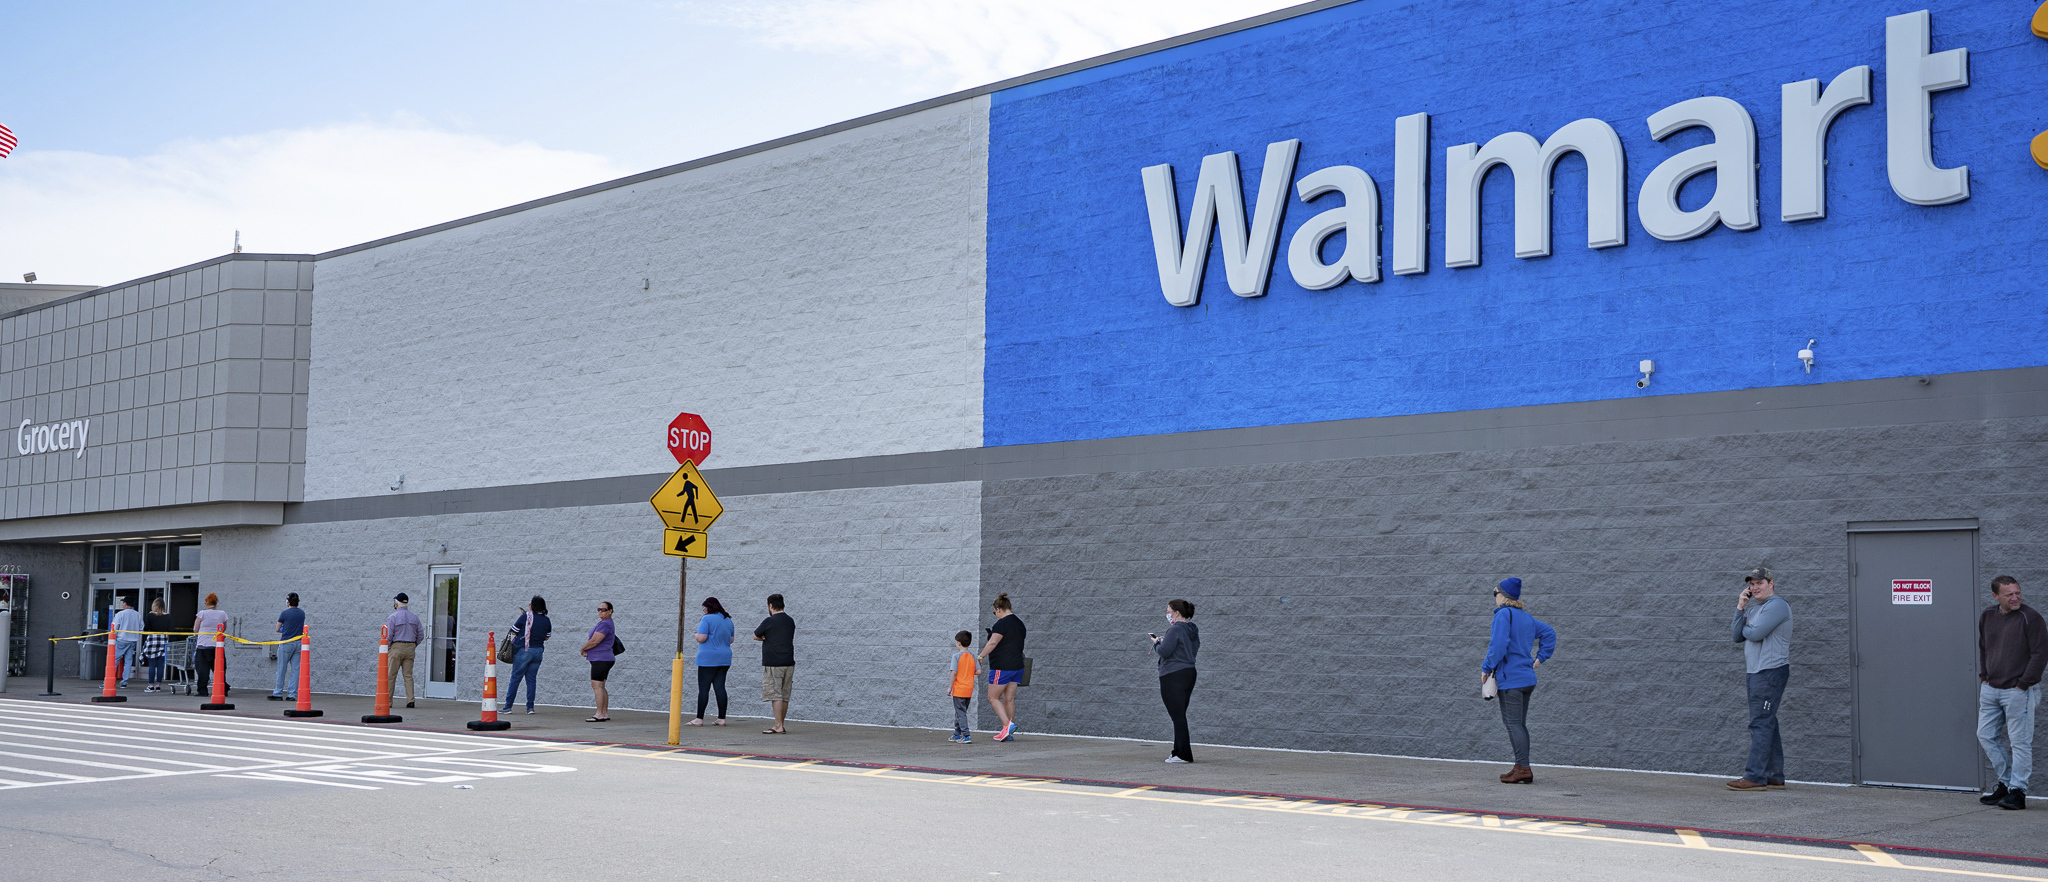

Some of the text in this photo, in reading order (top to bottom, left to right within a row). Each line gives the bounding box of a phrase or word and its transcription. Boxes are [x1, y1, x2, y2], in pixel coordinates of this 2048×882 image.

[1141, 9, 1970, 307] Walmart
[18, 419, 90, 459] Grocery
[669, 427, 709, 451] STOP
[210, 757, 578, 790] YIELD
[940, 775, 1607, 833] NO PARKING
